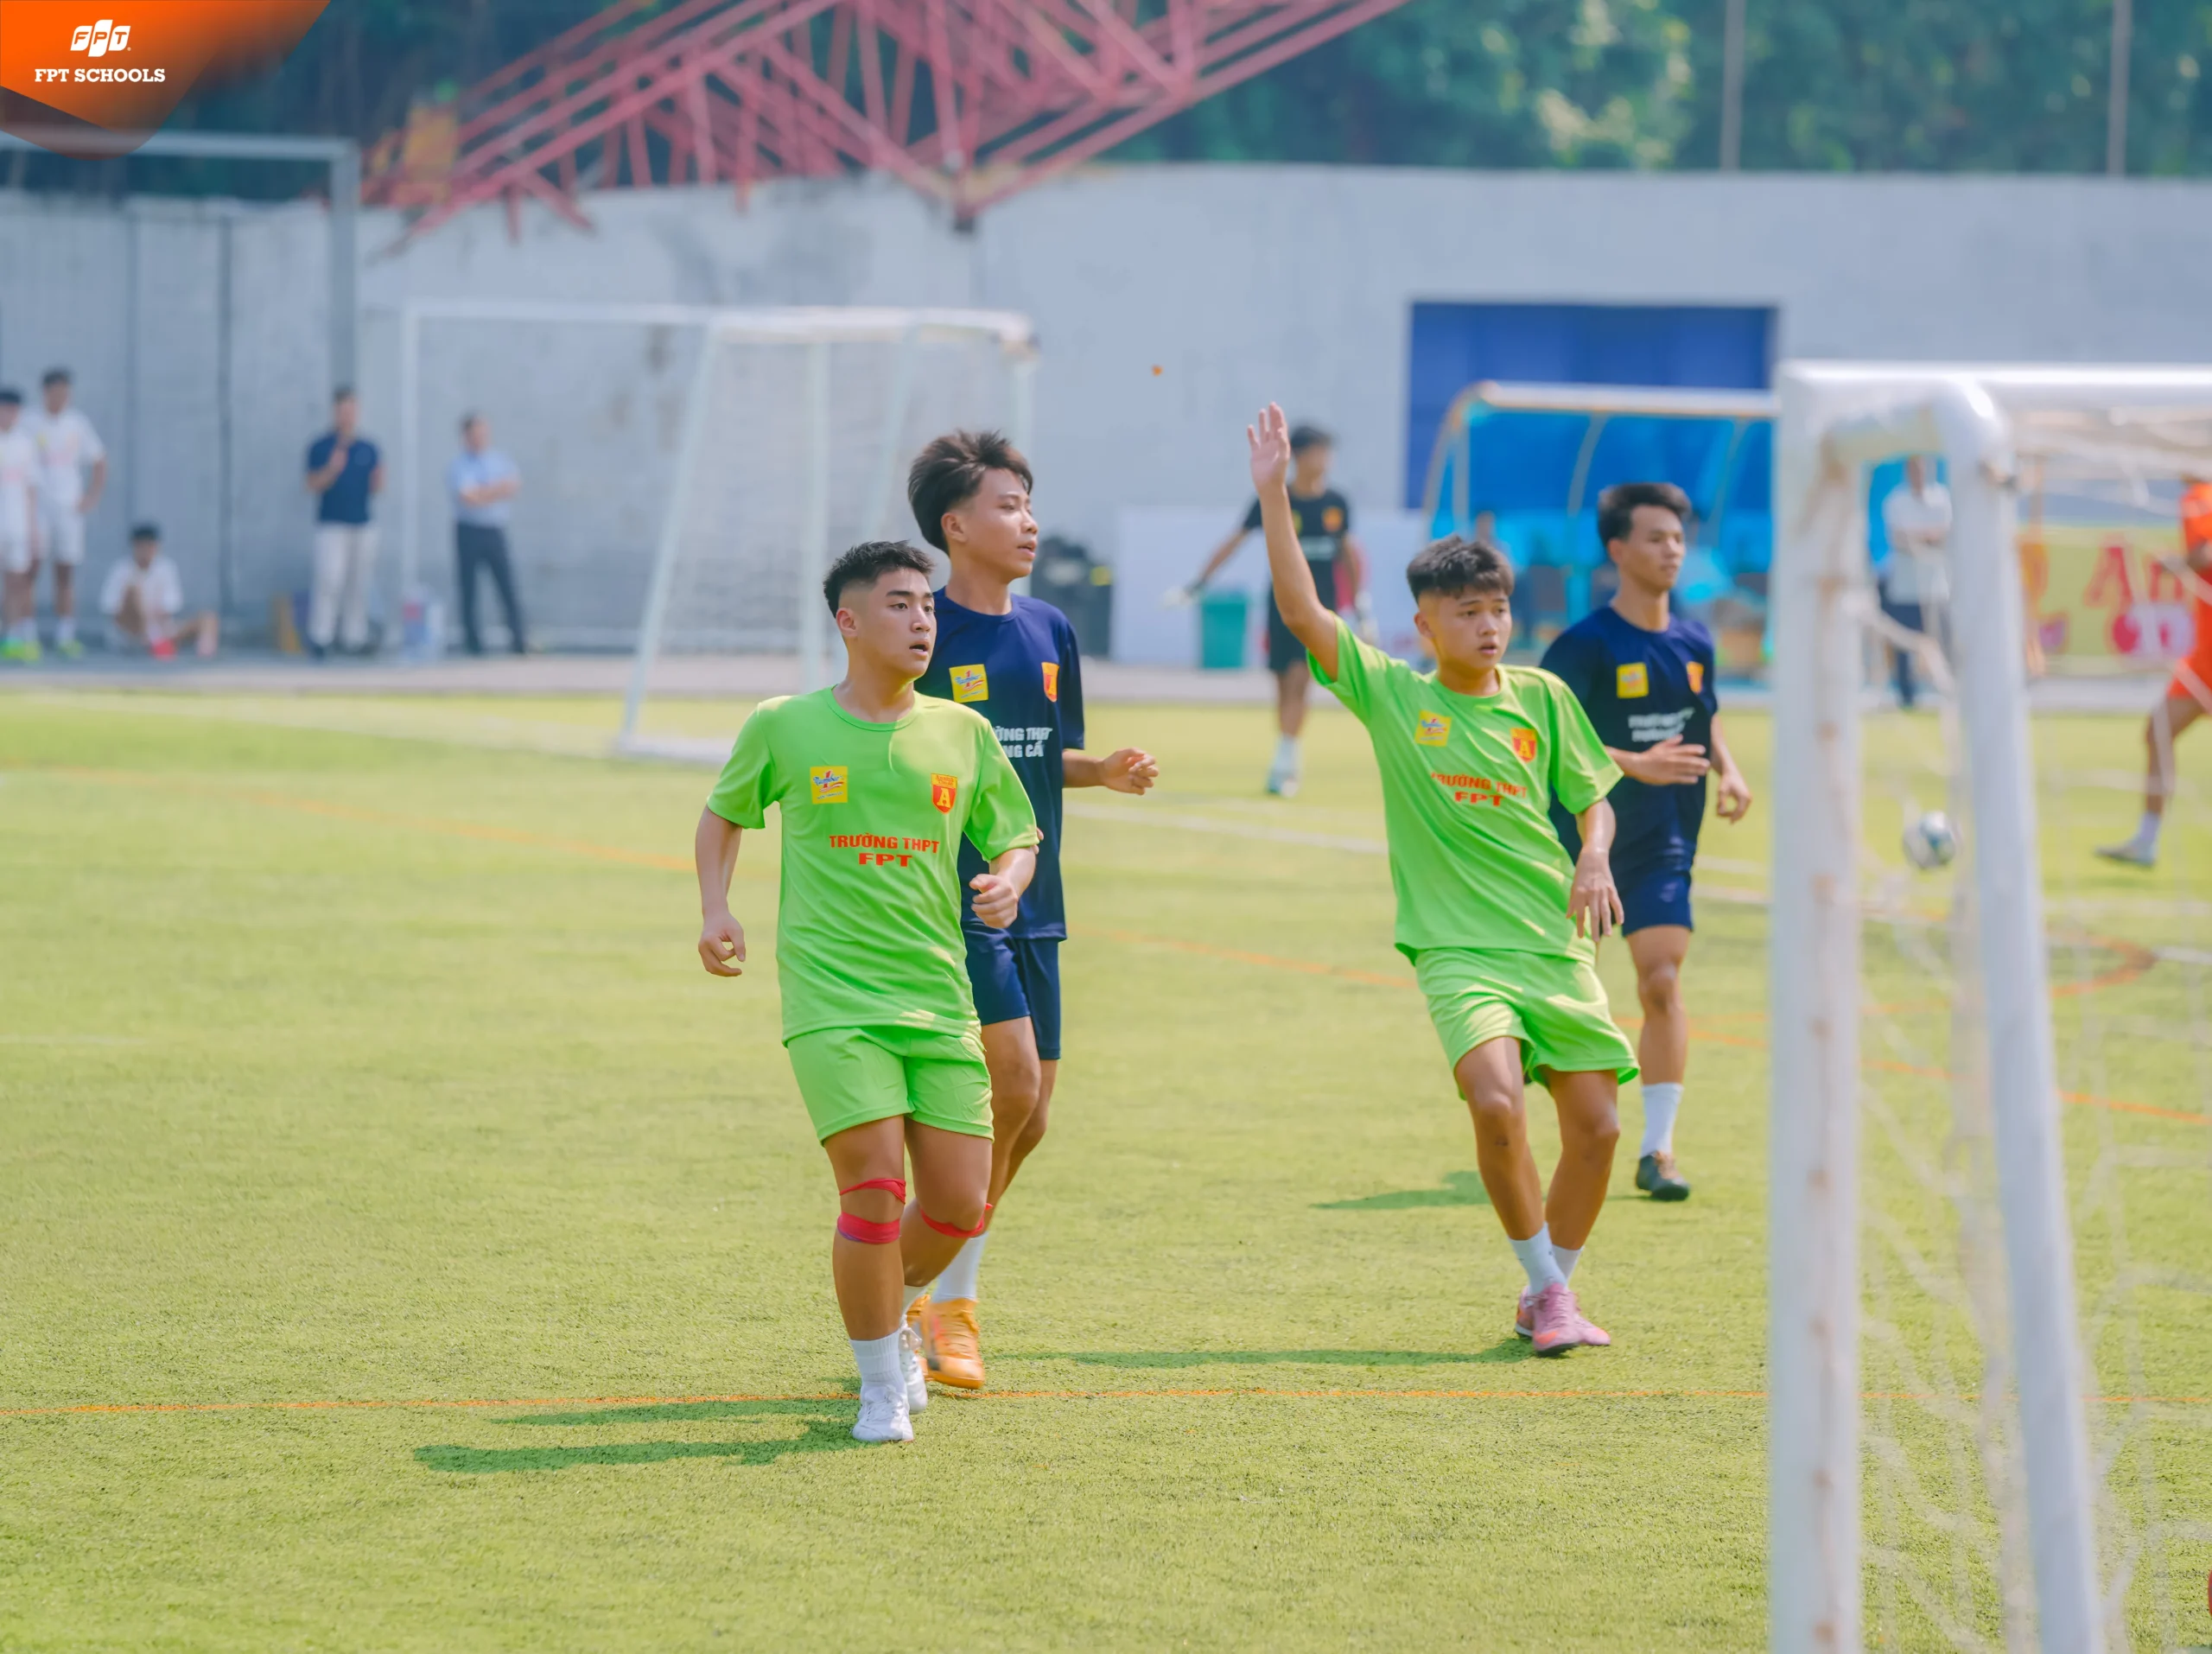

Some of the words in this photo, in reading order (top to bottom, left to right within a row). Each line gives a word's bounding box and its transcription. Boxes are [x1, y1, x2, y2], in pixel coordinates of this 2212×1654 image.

[937, 787, 951, 809] A
[1454, 791, 1504, 807] FPT
[829, 831, 898, 849] TRƯỜNG
[901, 837, 939, 854] THPT
[858, 852, 912, 868] FPT
